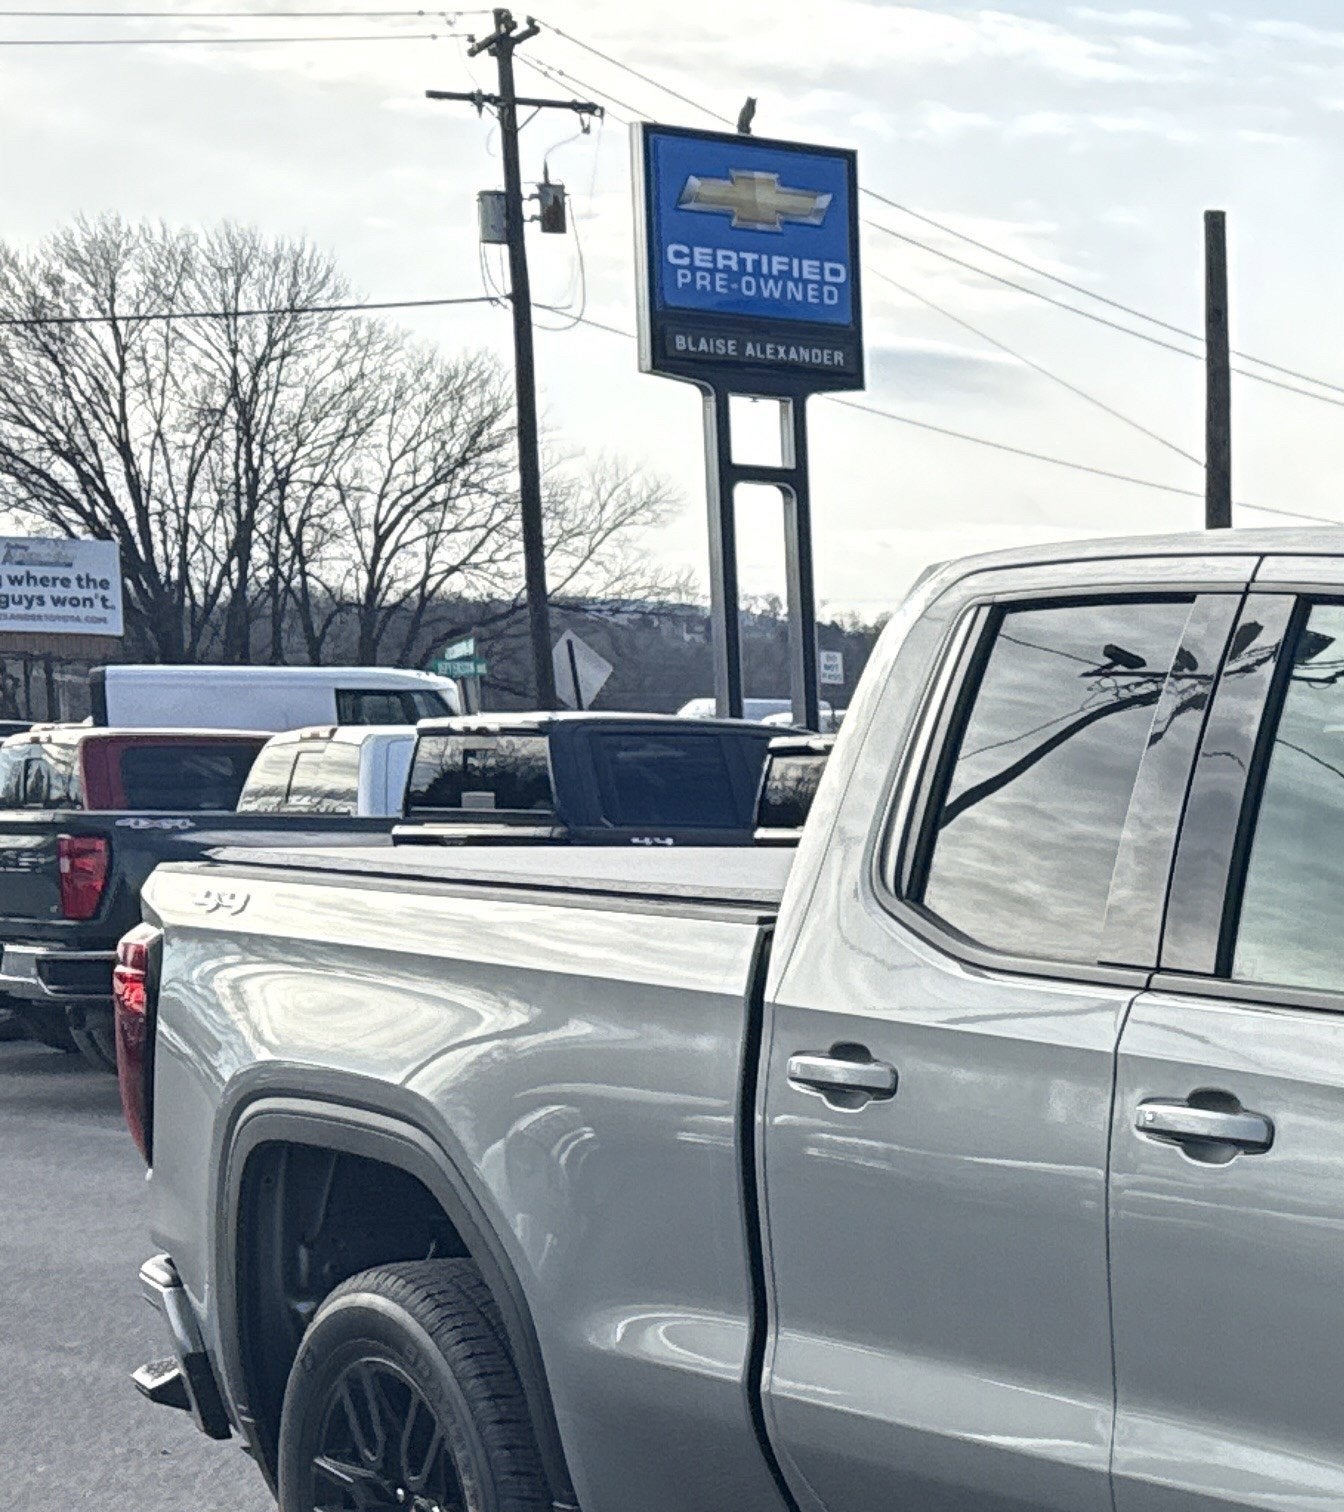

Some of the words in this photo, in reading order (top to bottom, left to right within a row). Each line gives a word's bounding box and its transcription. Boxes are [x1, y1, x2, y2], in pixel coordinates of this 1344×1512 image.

[666, 243, 847, 284] CERTIFIED
[676, 268, 839, 306] PRE-OWNED
[675, 334, 738, 357] BLAISE
[745, 341, 845, 367] ALEXANDER
[7, 570, 71, 589] where
[76, 572, 111, 591] the
[0, 593, 45, 611] guys
[50, 593, 117, 611] won't.
